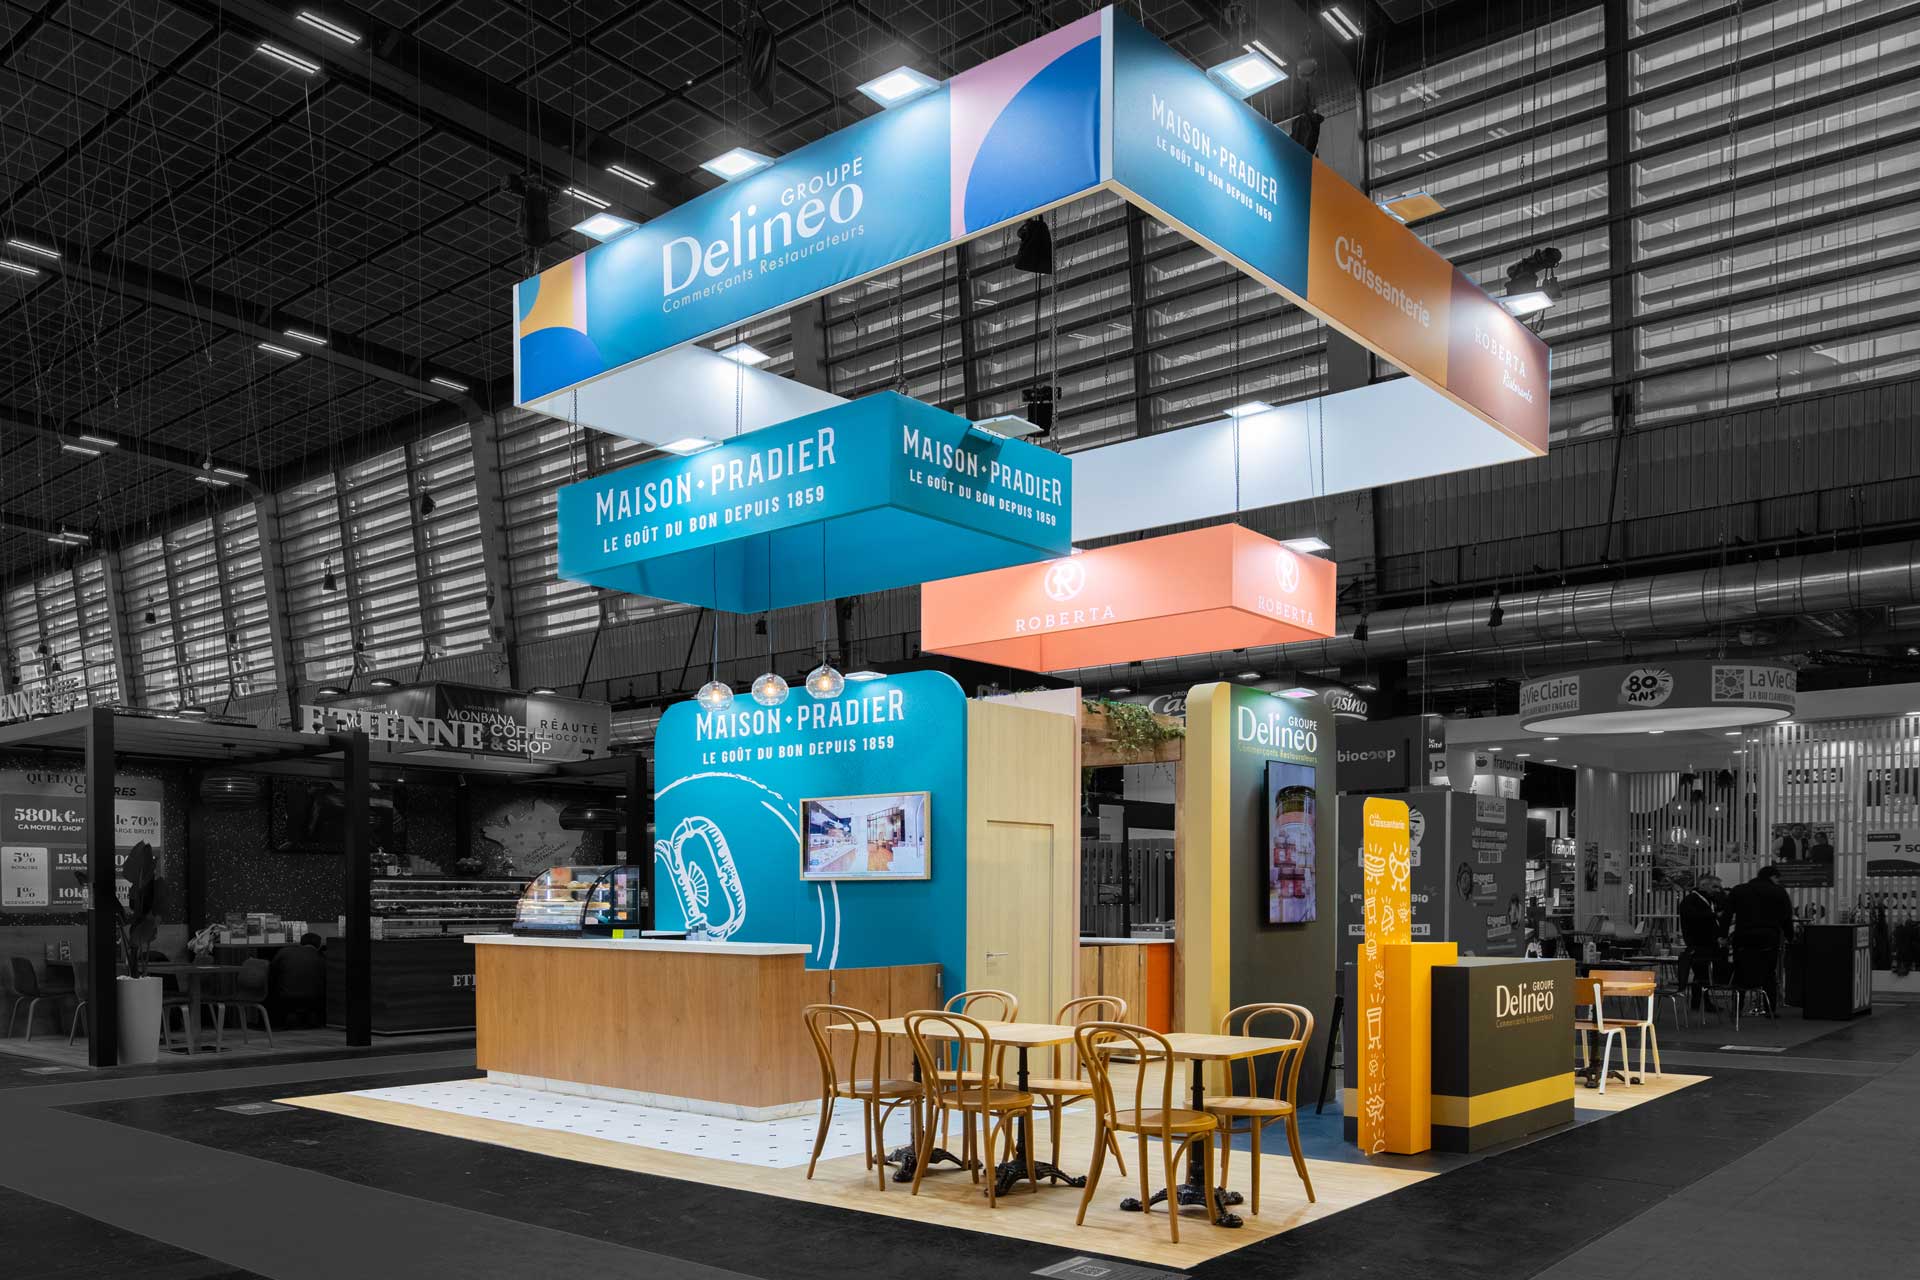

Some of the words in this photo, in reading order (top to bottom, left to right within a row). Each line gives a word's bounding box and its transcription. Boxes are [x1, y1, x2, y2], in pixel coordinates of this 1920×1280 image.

[781, 156, 864, 206] GROUPE
[1156, 137, 1168, 151] LE
[1170, 142, 1193, 168] GOÛT
[1194, 161, 1206, 177] DU
[1207, 169, 1225, 188] BON
[1226, 178, 1254, 212] DEPUIS
[1255, 202, 1272, 223] 1859
[662, 182, 864, 297] Delineo
[1350, 237, 1363, 258] La
[662, 267, 753, 314] Commerçants
[760, 223, 866, 274] Restaurateurs
[1334, 236, 1431, 329] Croissanterie
[1474, 327, 1527, 377] ROBERTA
[710, 426, 837, 496] PRADIER
[990, 463, 1063, 506] PRADIER
[910, 469, 922, 484] LE
[927, 472, 954, 492] GOÛT
[958, 482, 972, 498] DU
[976, 488, 995, 506] BON
[999, 494, 1032, 519] DEPUIS
[1036, 509, 1057, 527] 1859
[603, 536, 618, 554] LE
[624, 525, 659, 549] GOÛT
[665, 522, 683, 539] DU
[689, 513, 718, 534] BON
[724, 499, 780, 526] DEPUIS
[787, 485, 825, 509] 1859
[1015, 605, 1116, 632] ROBERTA
[1258, 595, 1314, 626] ROBERTA
[1526, 686, 1540, 704] Vie
[1540, 679, 1578, 701] Claire
[1628, 674, 1657, 692] 80
[1750, 670, 1765, 687] La
[1767, 670, 1785, 688] Vie
[797, 689, 905, 731] PRADIER
[1324, 689, 1368, 714] Casino
[1628, 691, 1656, 703] ANS
[447, 708, 516, 728] MONBANA
[541, 717, 598, 735] RÉAUTÉ
[1238, 705, 1318, 753] Delineo
[1288, 716, 1318, 731] GROUPE
[490, 736, 504, 752] &
[507, 738, 553, 754] SHOP
[545, 732, 599, 745] HOCOLAT
[703, 752, 717, 765] LE
[721, 745, 752, 764] GOÛT
[757, 747, 773, 760] DU
[778, 744, 803, 758] BON
[809, 739, 856, 756] DEPUIS
[862, 735, 895, 751] 1859
[1337, 749, 1396, 764] biocoop
[131, 815, 159, 827] 70%
[13, 851, 36, 864] 5%
[16, 887, 36, 898] 1%
[1532, 979, 1554, 991] GROUPE
[1496, 982, 1554, 1018] Delineo
